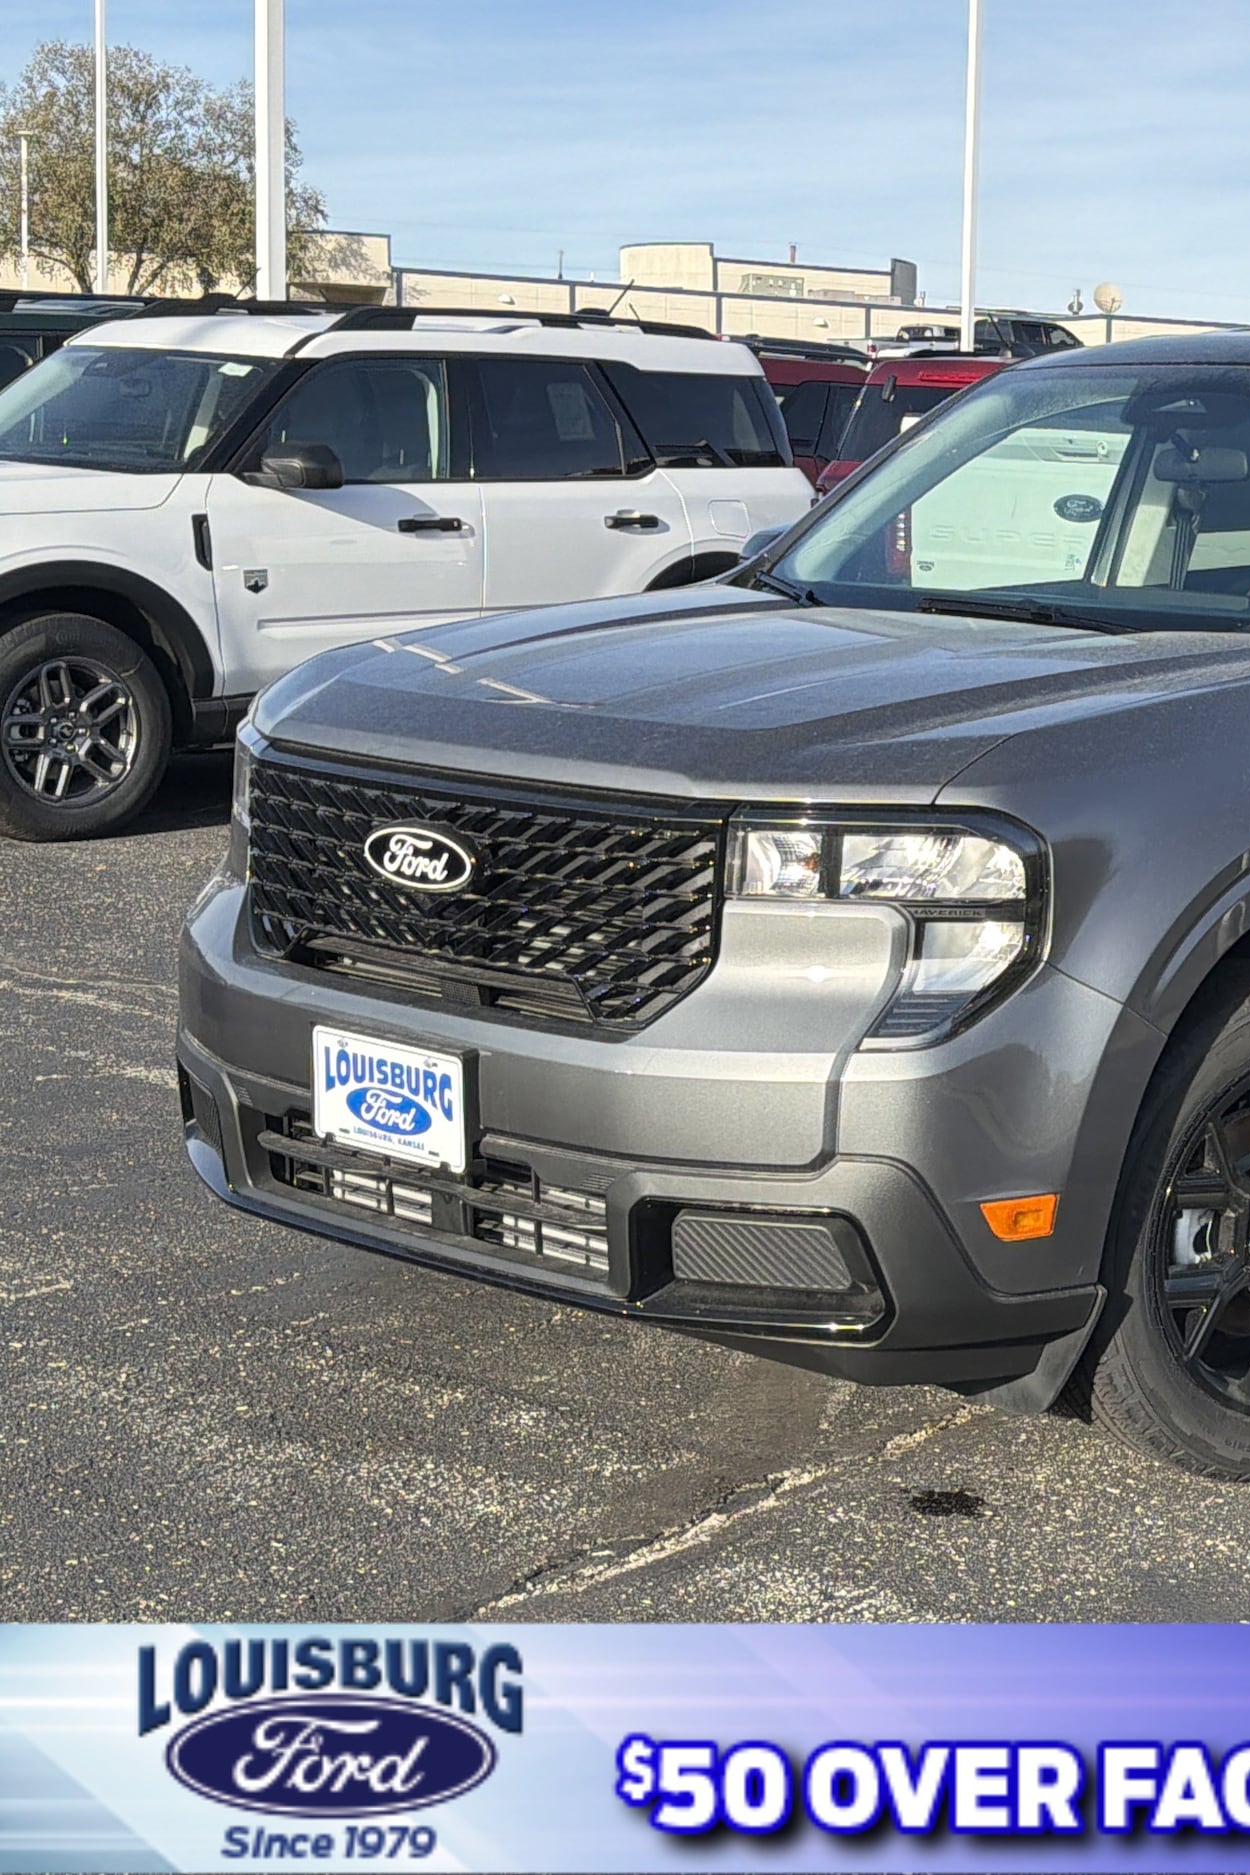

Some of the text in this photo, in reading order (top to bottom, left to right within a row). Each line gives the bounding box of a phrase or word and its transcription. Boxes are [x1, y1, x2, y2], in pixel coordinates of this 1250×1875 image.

[383, 833, 450, 881] Ford
[324, 1046, 453, 1122] LOUISBURG
[361, 1089, 416, 1132] Ford
